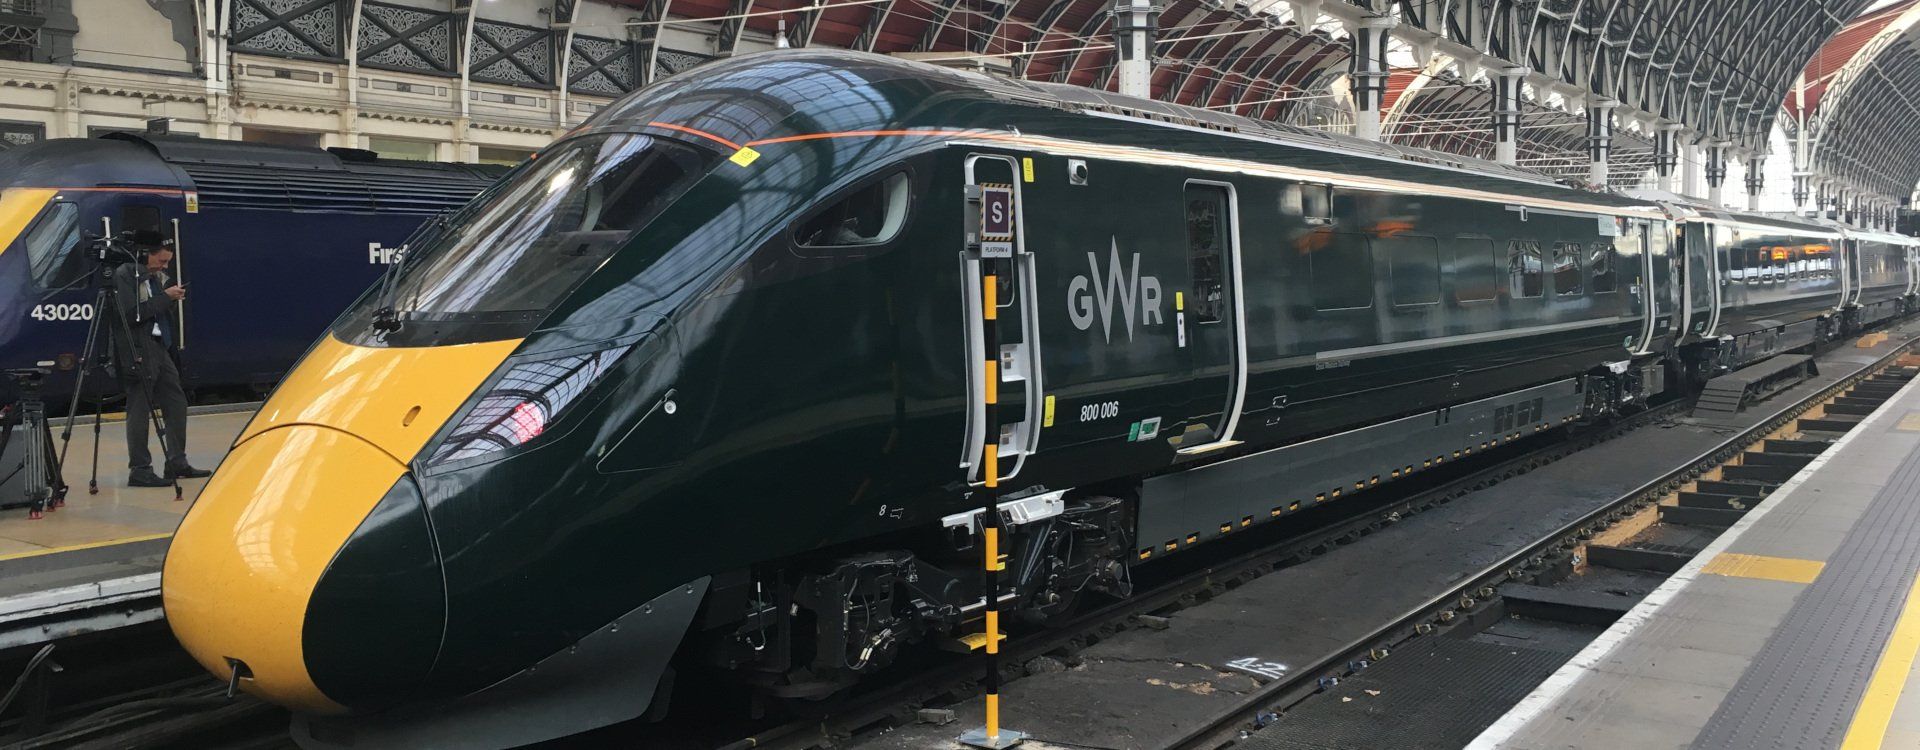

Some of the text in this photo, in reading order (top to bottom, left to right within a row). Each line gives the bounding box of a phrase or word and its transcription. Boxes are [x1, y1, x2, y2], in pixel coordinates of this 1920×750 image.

[992, 201, 1003, 224] S
[1067, 234, 1163, 344] GWR
[31, 304, 94, 321] 43020
[1080, 401, 1119, 422] 800 006
[879, 504, 887, 516] 8
